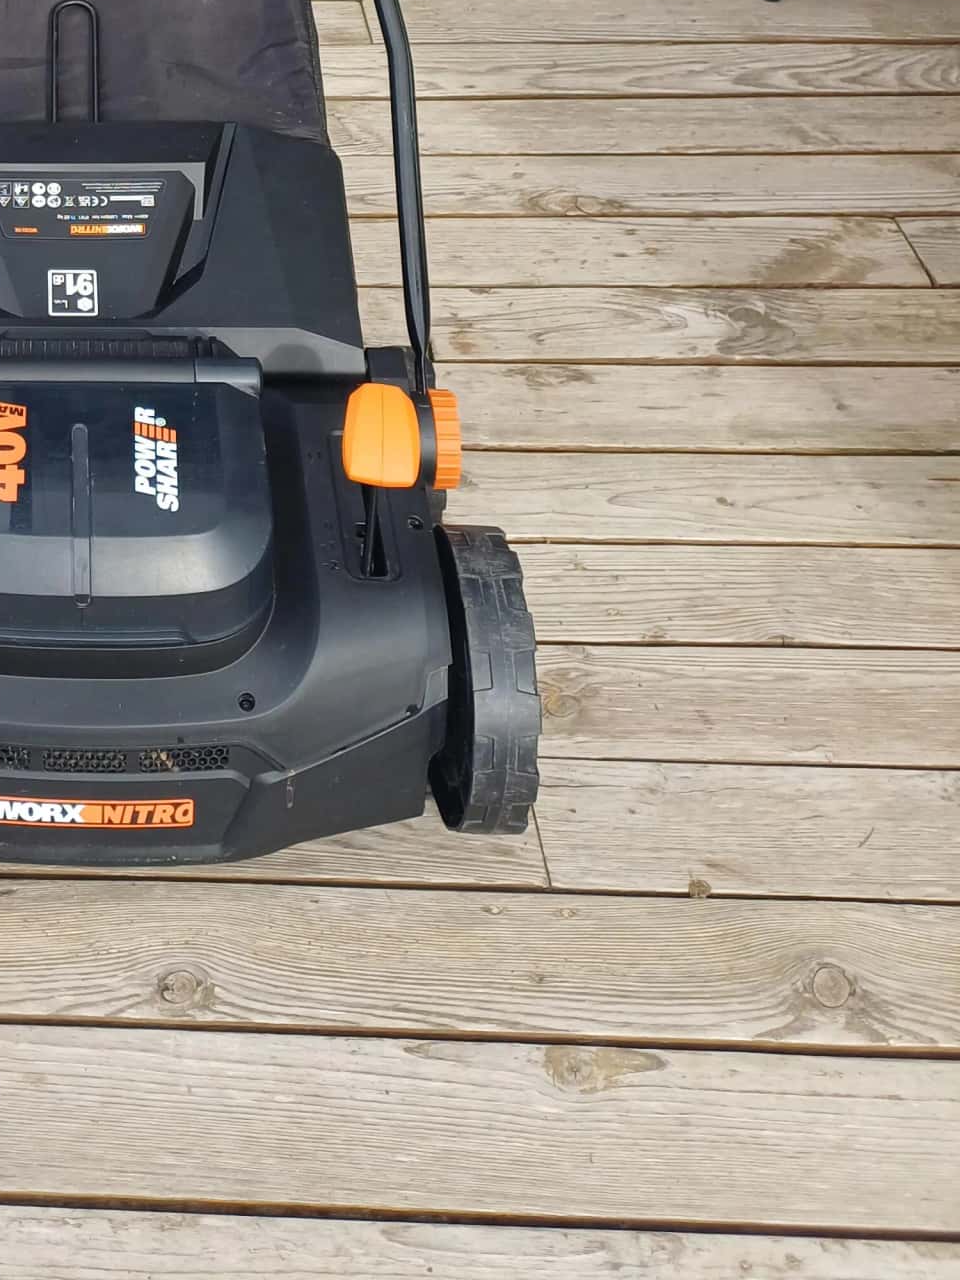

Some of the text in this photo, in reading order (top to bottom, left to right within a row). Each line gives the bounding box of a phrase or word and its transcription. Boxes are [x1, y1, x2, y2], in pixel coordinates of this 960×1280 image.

[65, 273, 94, 297] 91
[134, 406, 156, 496] POWER
[156, 427, 179, 512] SHARE
[100, 803, 193, 825] NITRO
